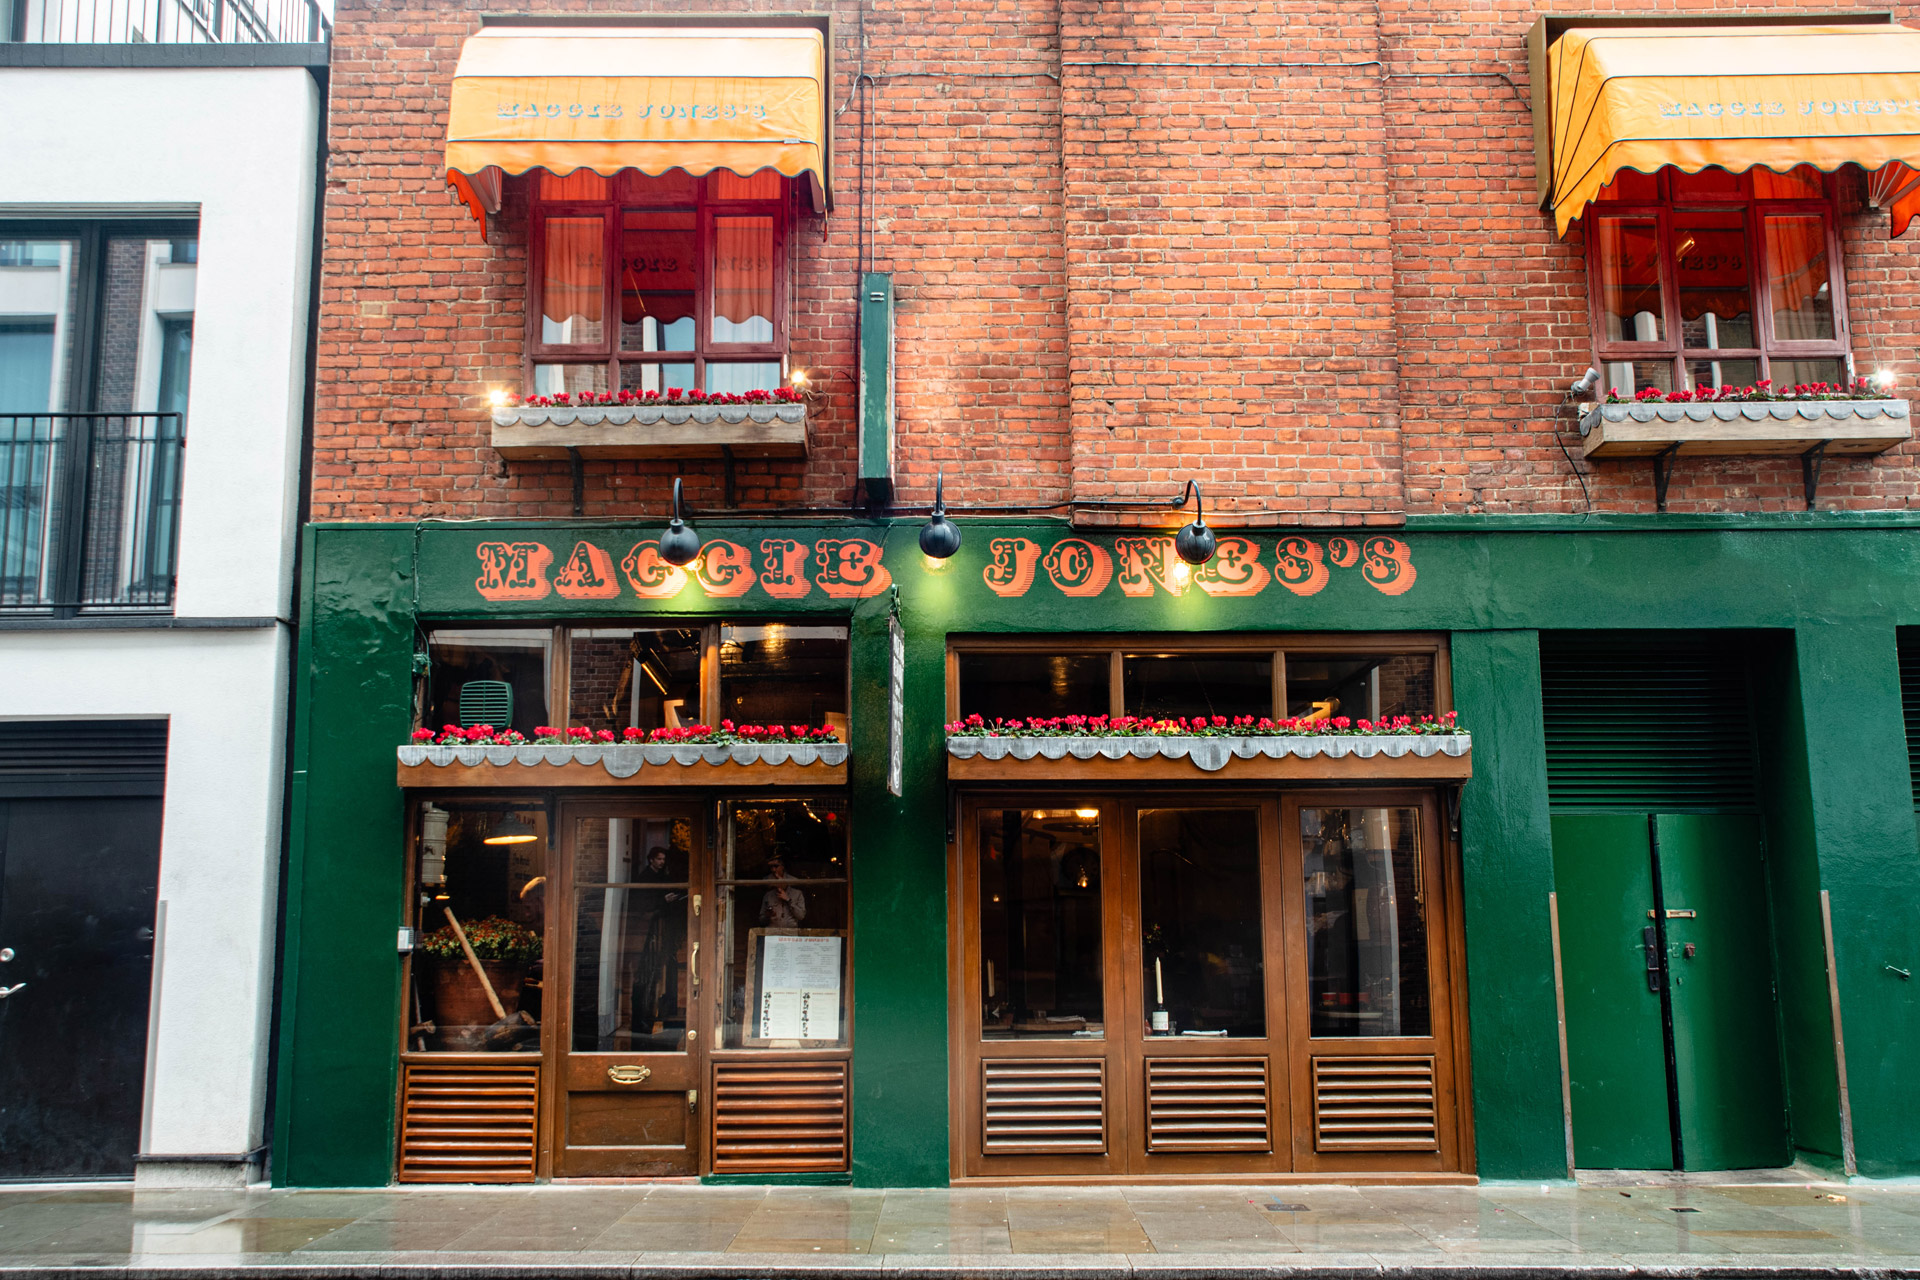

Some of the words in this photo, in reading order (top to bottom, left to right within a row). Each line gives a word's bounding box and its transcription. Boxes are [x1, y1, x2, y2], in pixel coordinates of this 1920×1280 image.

[497, 102, 623, 119] MAGGIE
[637, 102, 767, 119] JONES'S
[1659, 101, 1785, 118] MAGGIE
[475, 538, 892, 601] MAGGIE
[982, 536, 1418, 597] JONES'S
